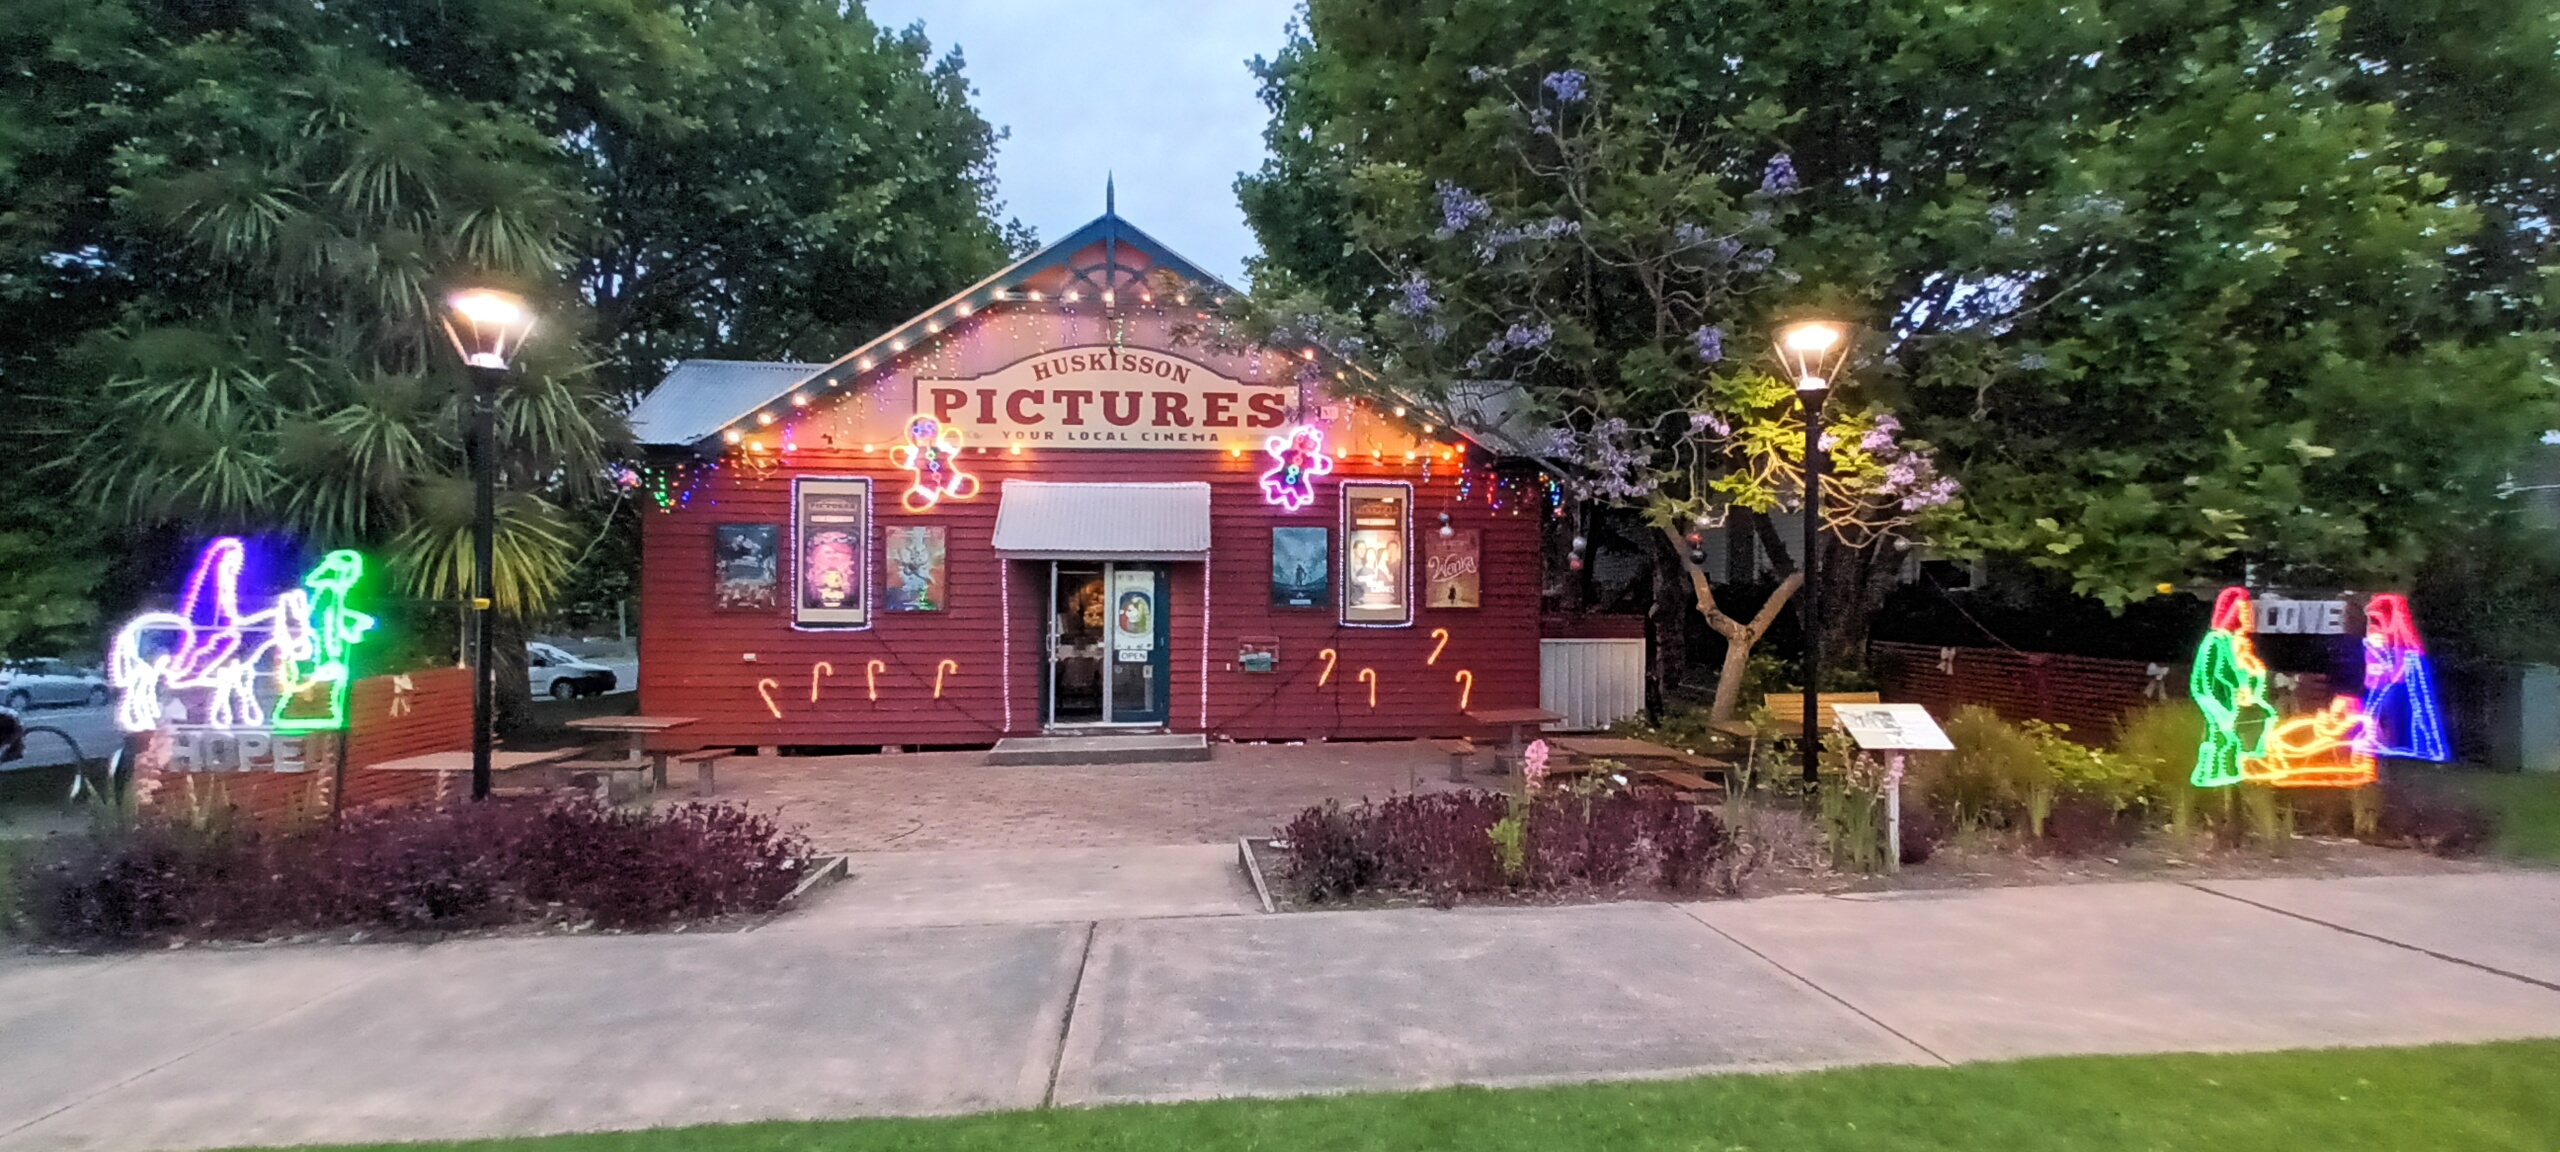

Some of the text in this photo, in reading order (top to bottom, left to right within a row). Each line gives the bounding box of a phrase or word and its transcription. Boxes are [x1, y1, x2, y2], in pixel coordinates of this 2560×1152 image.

[1032, 353, 1191, 384] HUSKISSON
[930, 388, 1286, 428] PICTURES
[1002, 430, 1219, 442] YOUR LOCAL CINEMA
[1427, 553, 1477, 582] Wonka
[1121, 652, 1146, 660] OPEN
[170, 731, 306, 773] HOPE
